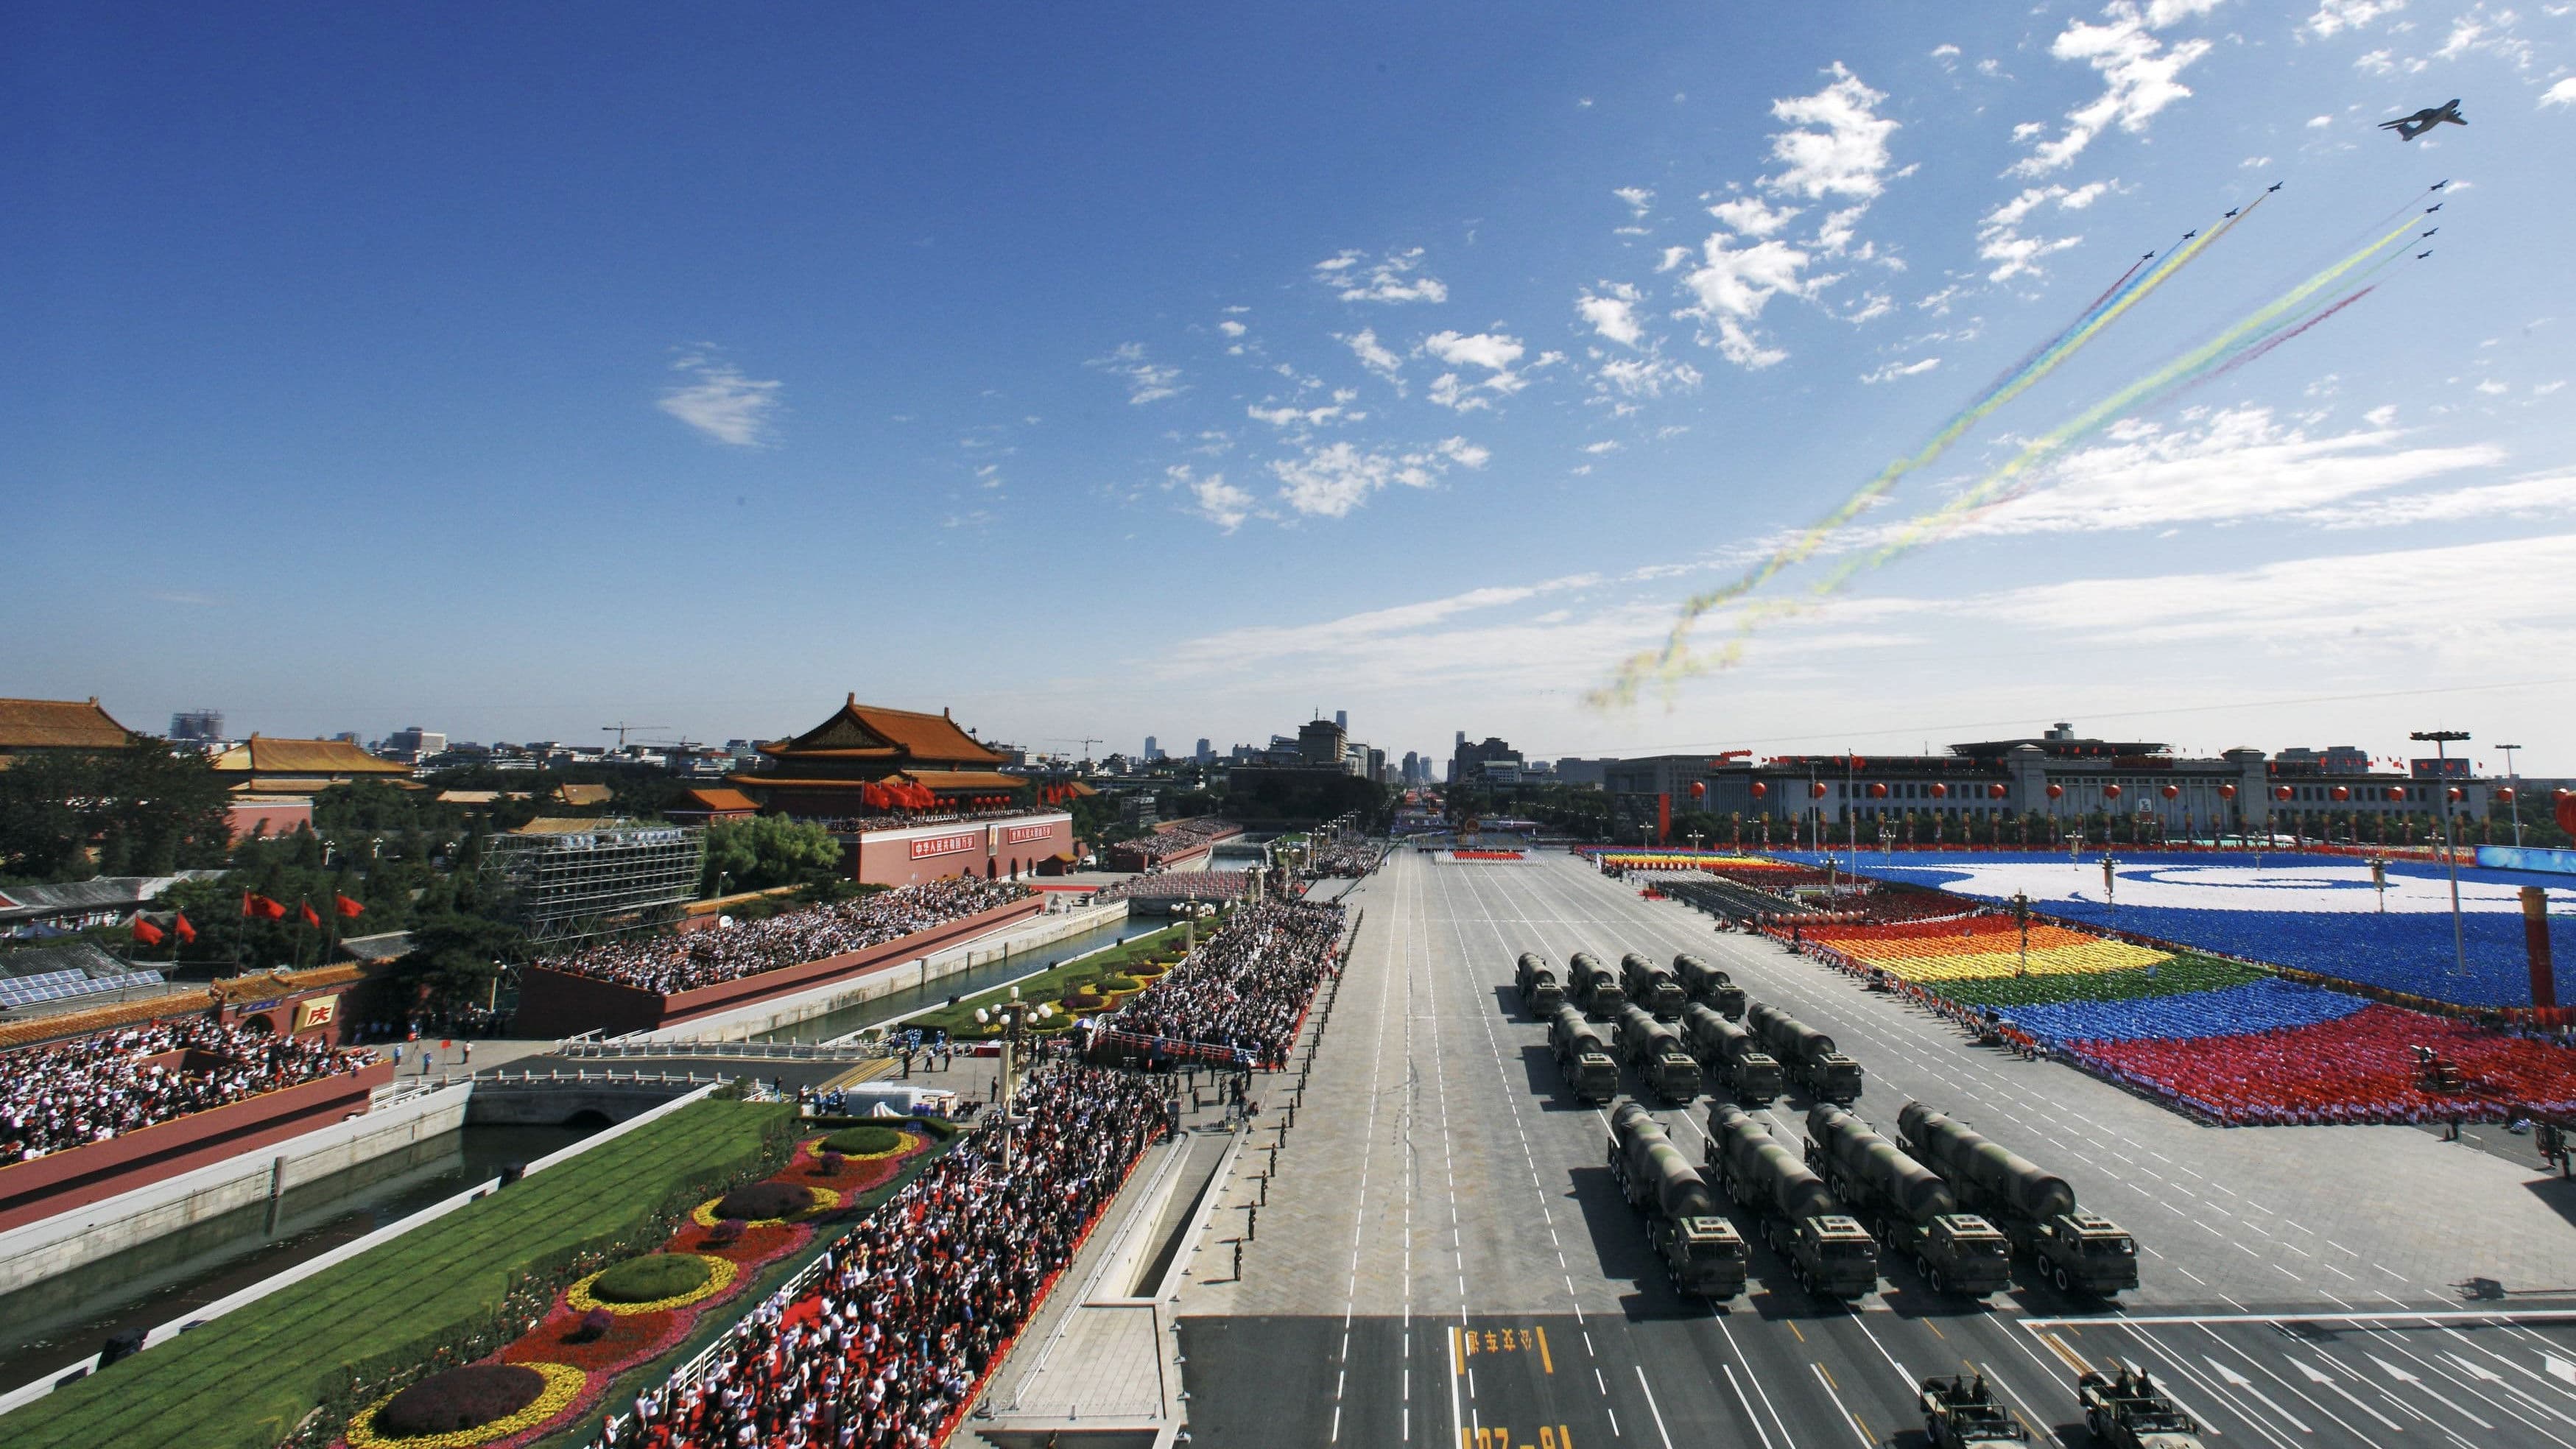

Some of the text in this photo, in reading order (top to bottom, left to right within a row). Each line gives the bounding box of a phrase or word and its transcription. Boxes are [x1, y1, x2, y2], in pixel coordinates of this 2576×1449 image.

[915, 836, 974, 856] 中华人民共和国万岁
[307, 1006, 331, 1025] 庆
